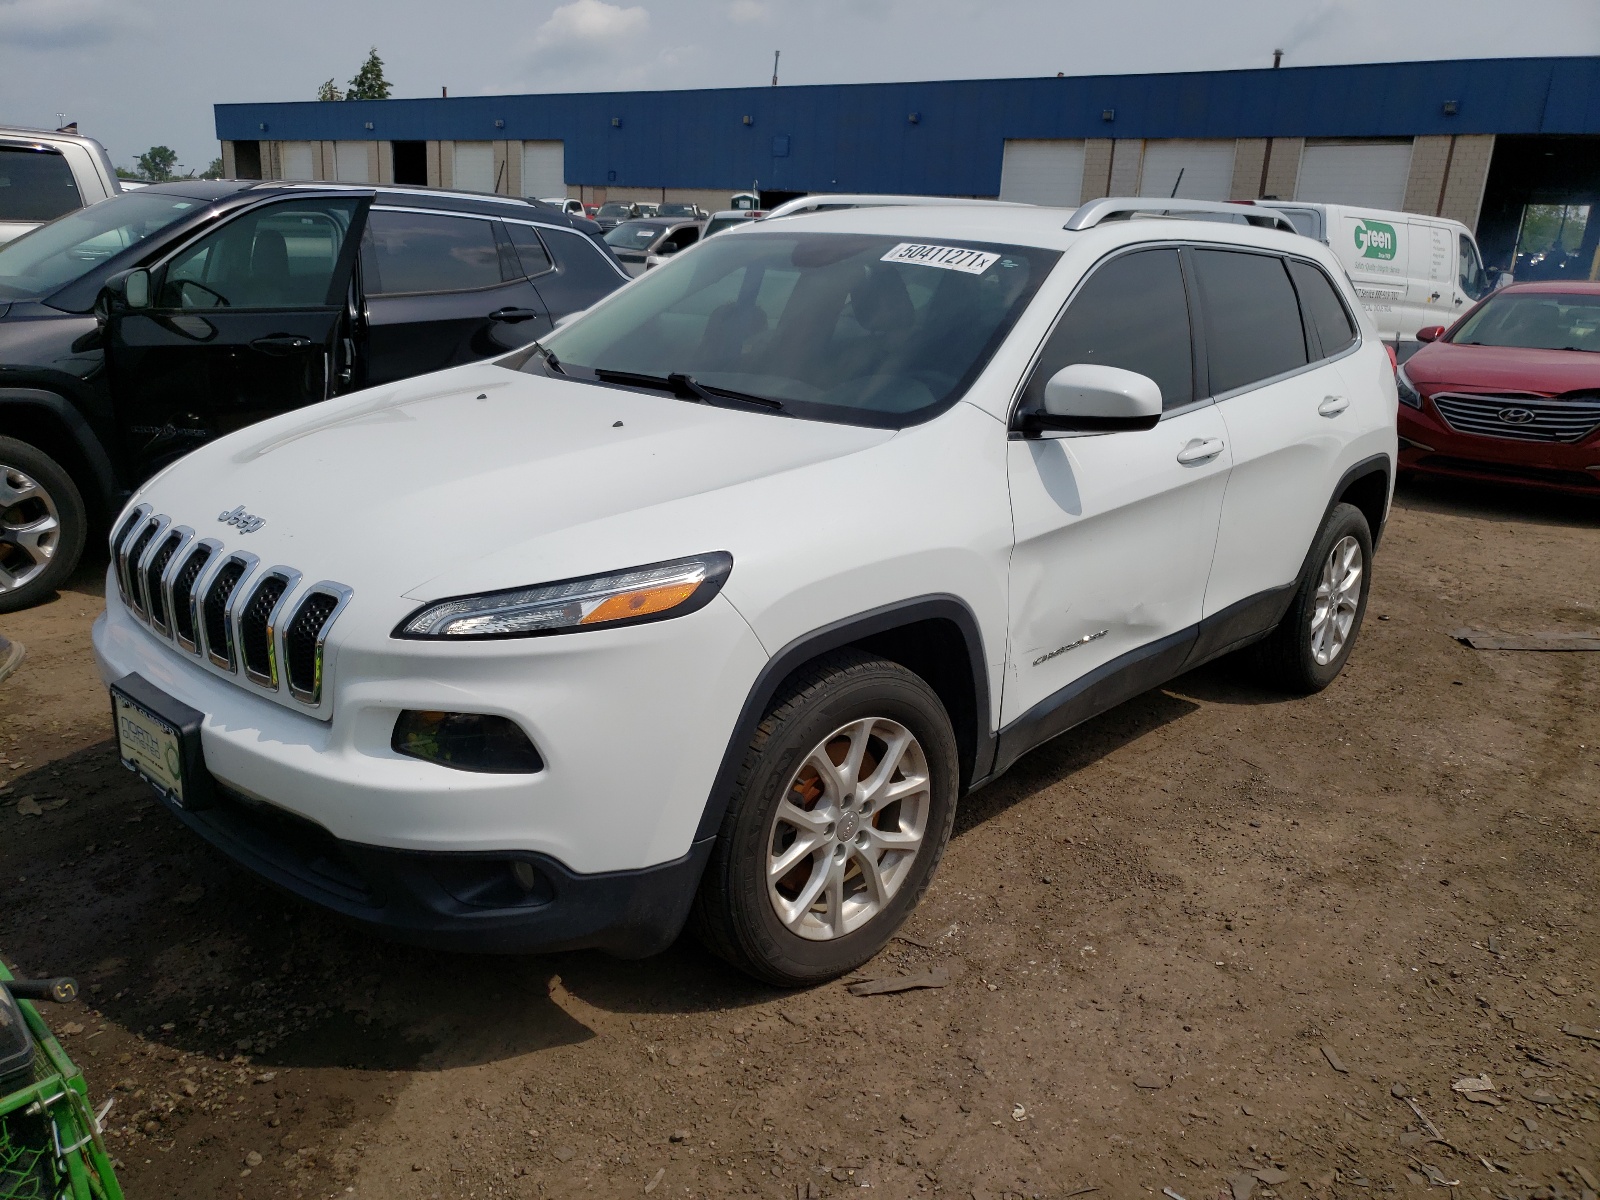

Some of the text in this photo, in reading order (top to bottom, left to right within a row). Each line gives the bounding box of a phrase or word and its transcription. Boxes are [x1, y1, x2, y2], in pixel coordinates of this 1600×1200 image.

[1354, 220, 1392, 257] Green
[218, 505, 266, 535] Jeep
[121, 717, 159, 746] NORTH
